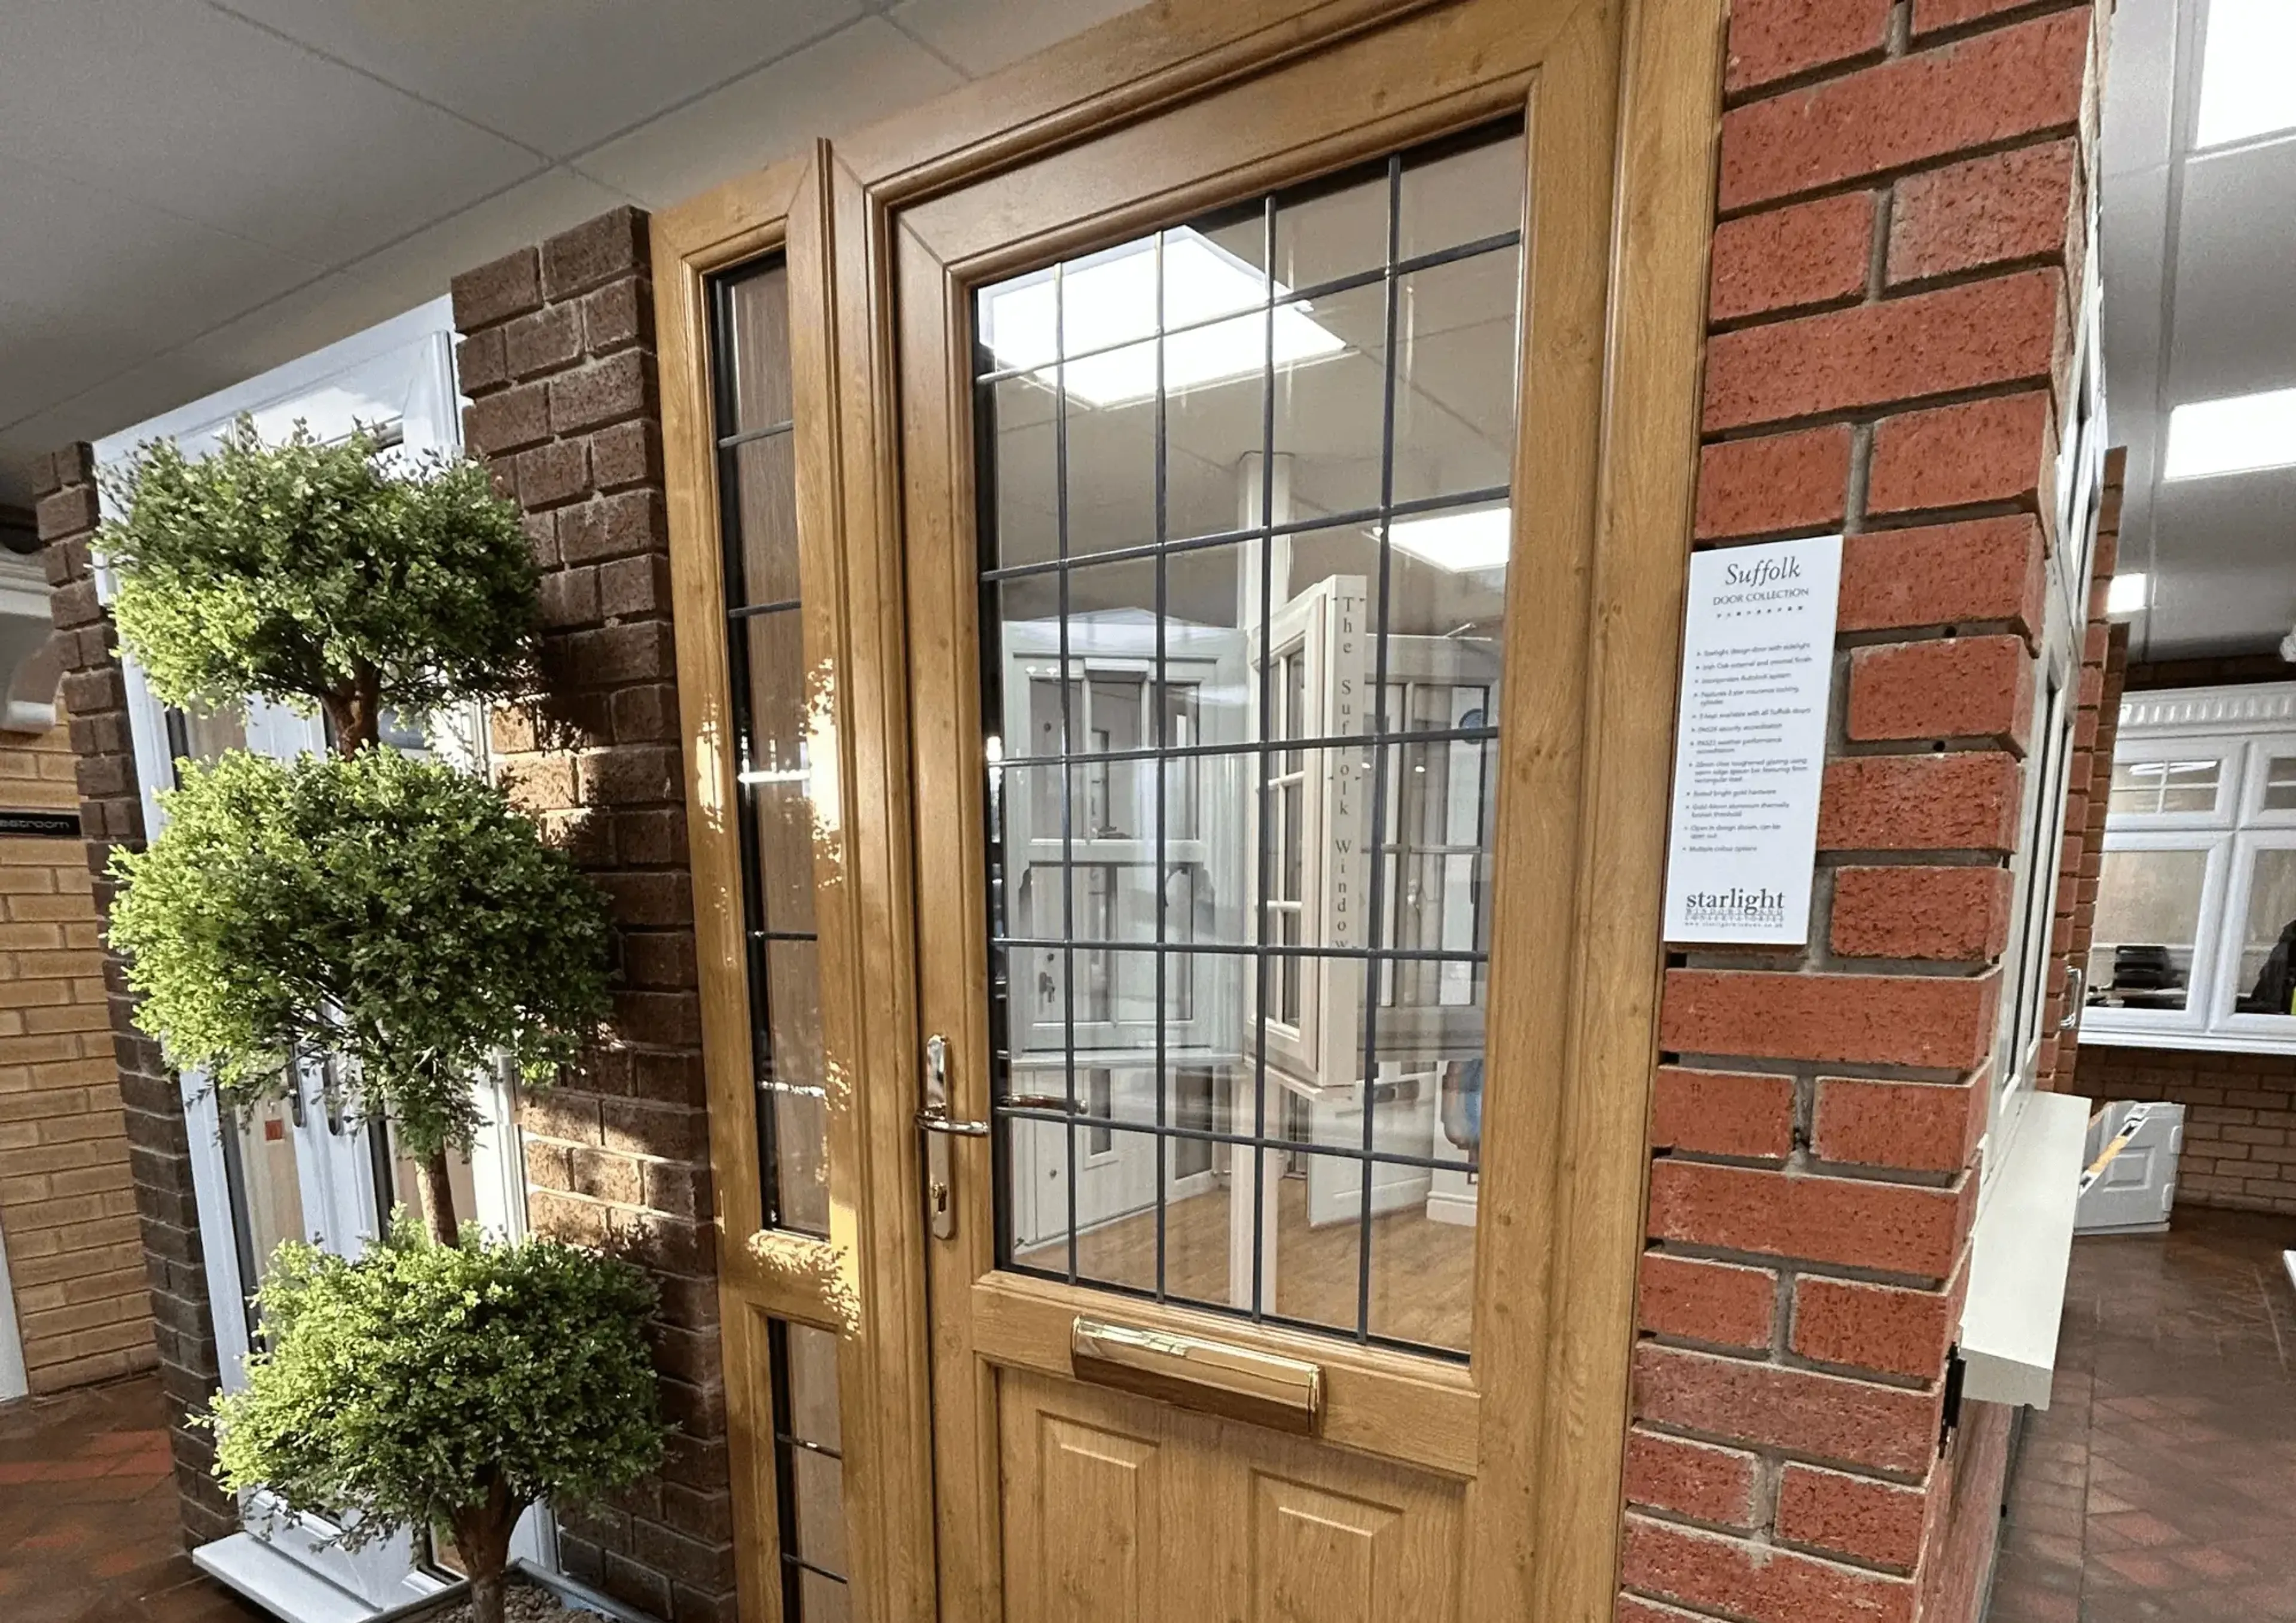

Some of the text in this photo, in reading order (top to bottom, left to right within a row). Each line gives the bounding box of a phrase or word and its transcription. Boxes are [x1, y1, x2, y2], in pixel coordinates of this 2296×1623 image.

[1725, 556, 1800, 587] Suffolk
[1712, 588, 1809, 606] DOOR COLLECTION
[1342, 597, 1354, 653] The
[1686, 887, 1785, 915] starlight
